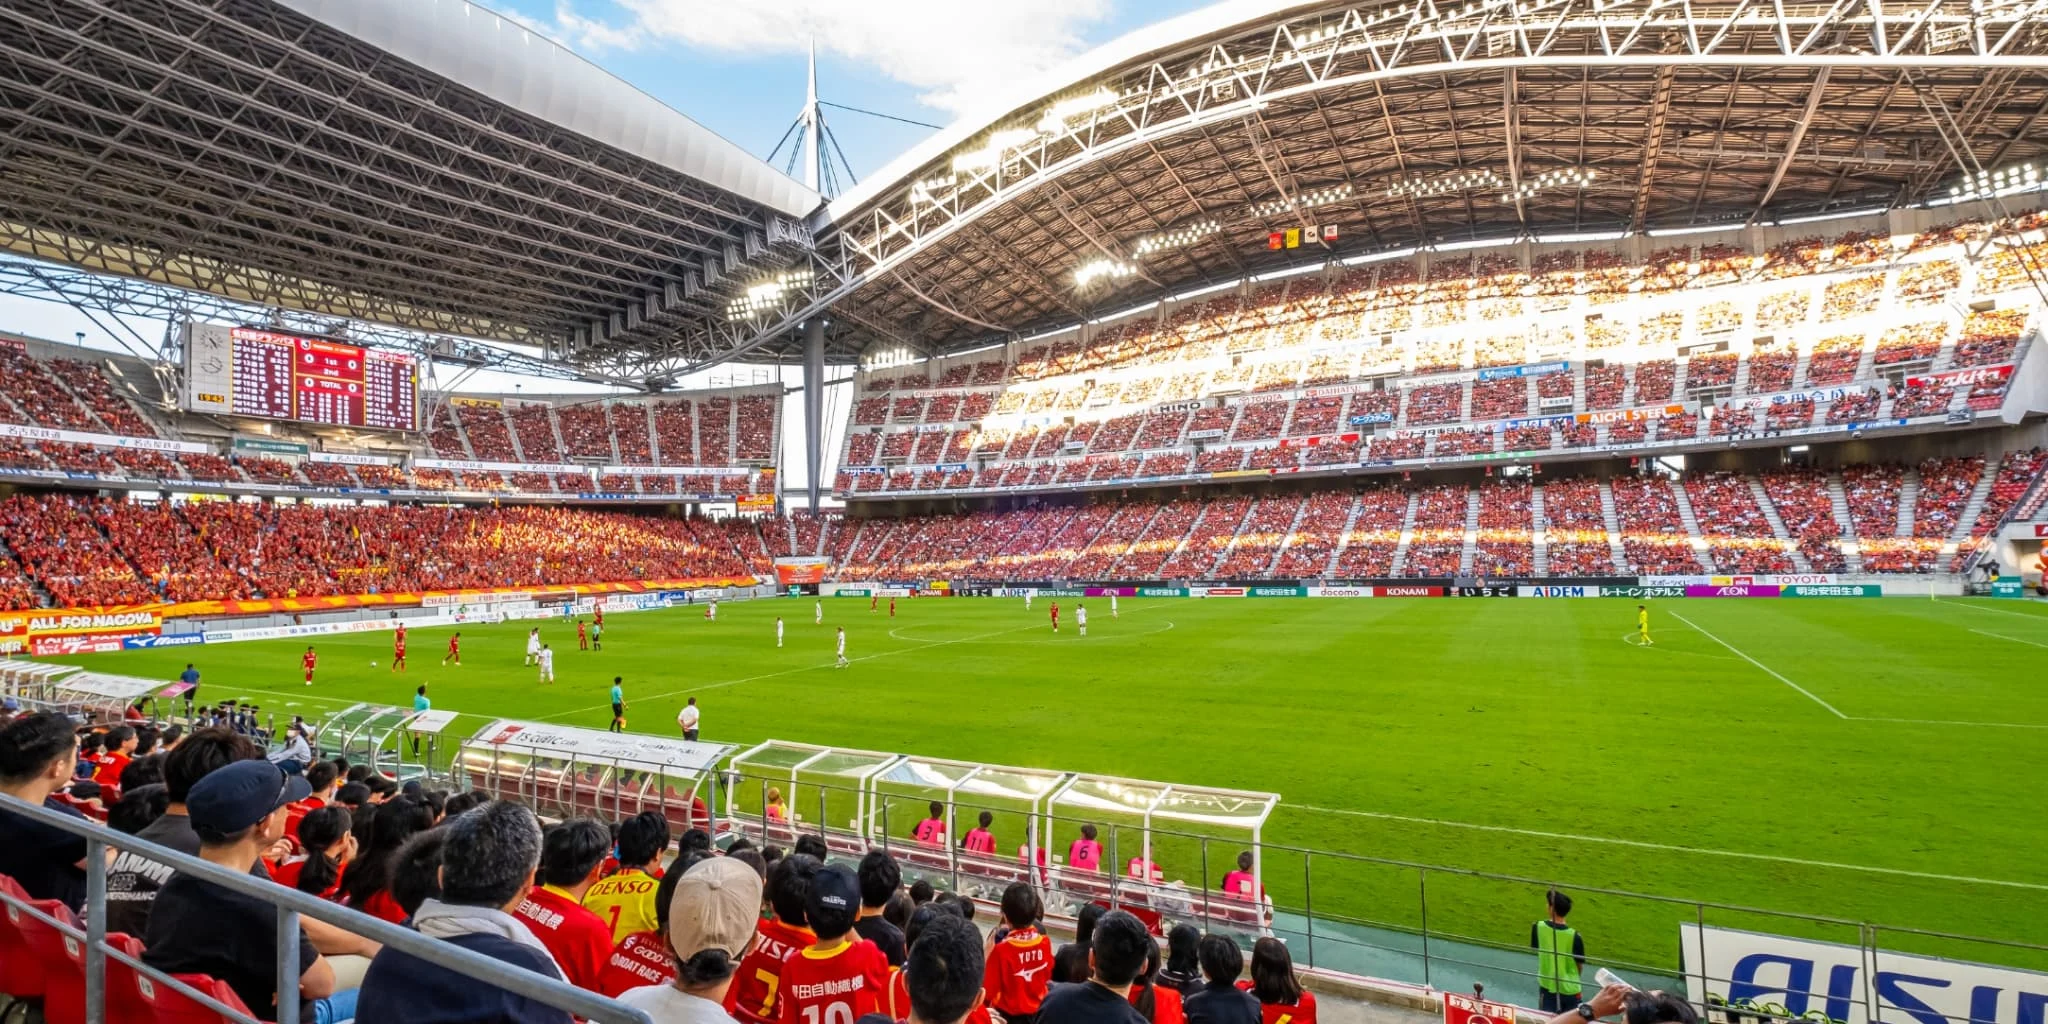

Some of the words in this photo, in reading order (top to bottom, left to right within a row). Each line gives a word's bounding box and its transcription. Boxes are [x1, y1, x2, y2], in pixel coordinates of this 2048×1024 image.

[1160, 402, 1201, 413] HINO
[1590, 413, 1627, 425] AICHI
[1774, 575, 1828, 584] TOYOTA
[1320, 587, 1360, 596] docomo
[1386, 588, 1428, 596] KONAMI
[1796, 586, 1864, 596] 明治安田生命
[30, 616, 58, 631] ALL
[61, 614, 91, 629] FOR
[91, 611, 154, 628] NAGOYA
[924, 826, 933, 840] 3
[1079, 845, 1089, 860] 6
[590, 880, 654, 897] DENSO
[608, 905, 622, 939] 1
[633, 945, 663, 963] GOOD
[1018, 949, 1044, 964] YUTO
[755, 967, 779, 1017] 7
